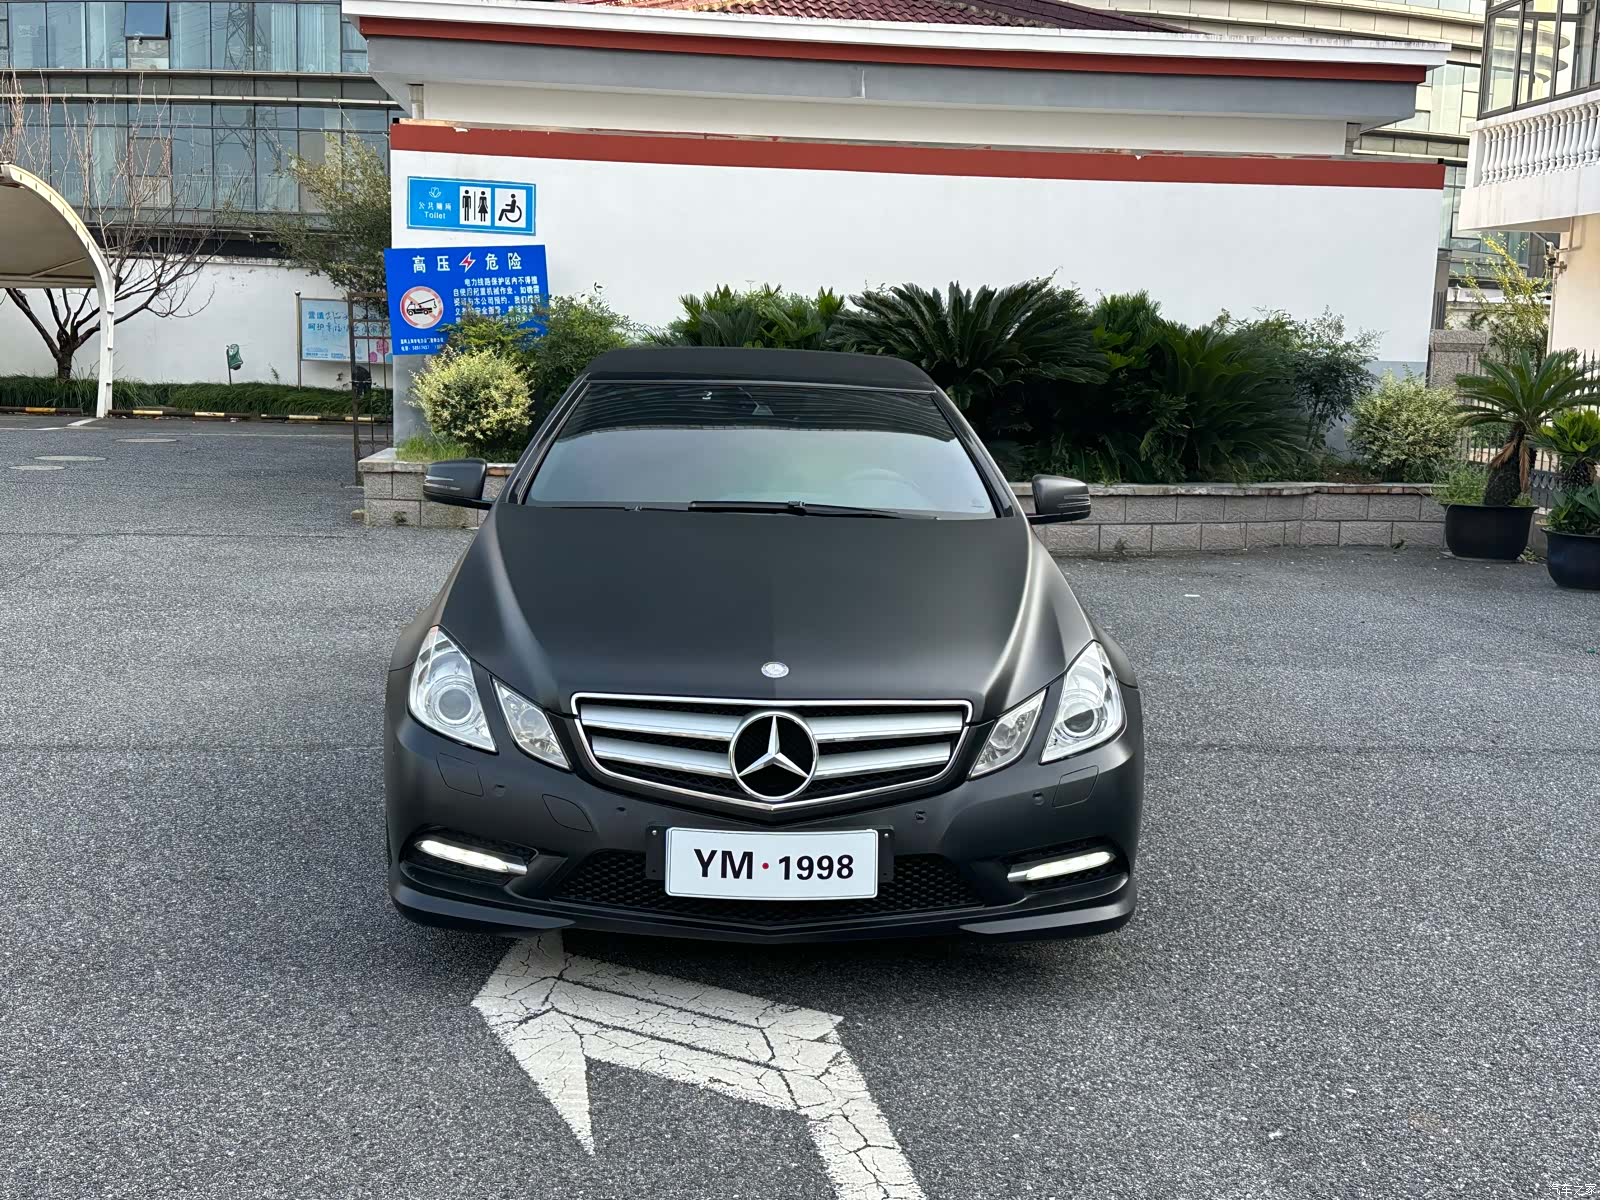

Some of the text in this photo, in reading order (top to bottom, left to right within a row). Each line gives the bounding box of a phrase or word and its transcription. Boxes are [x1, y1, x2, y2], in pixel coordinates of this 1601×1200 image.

[424, 211, 446, 219] Toilet
[412, 252, 522, 273] 高压 危险
